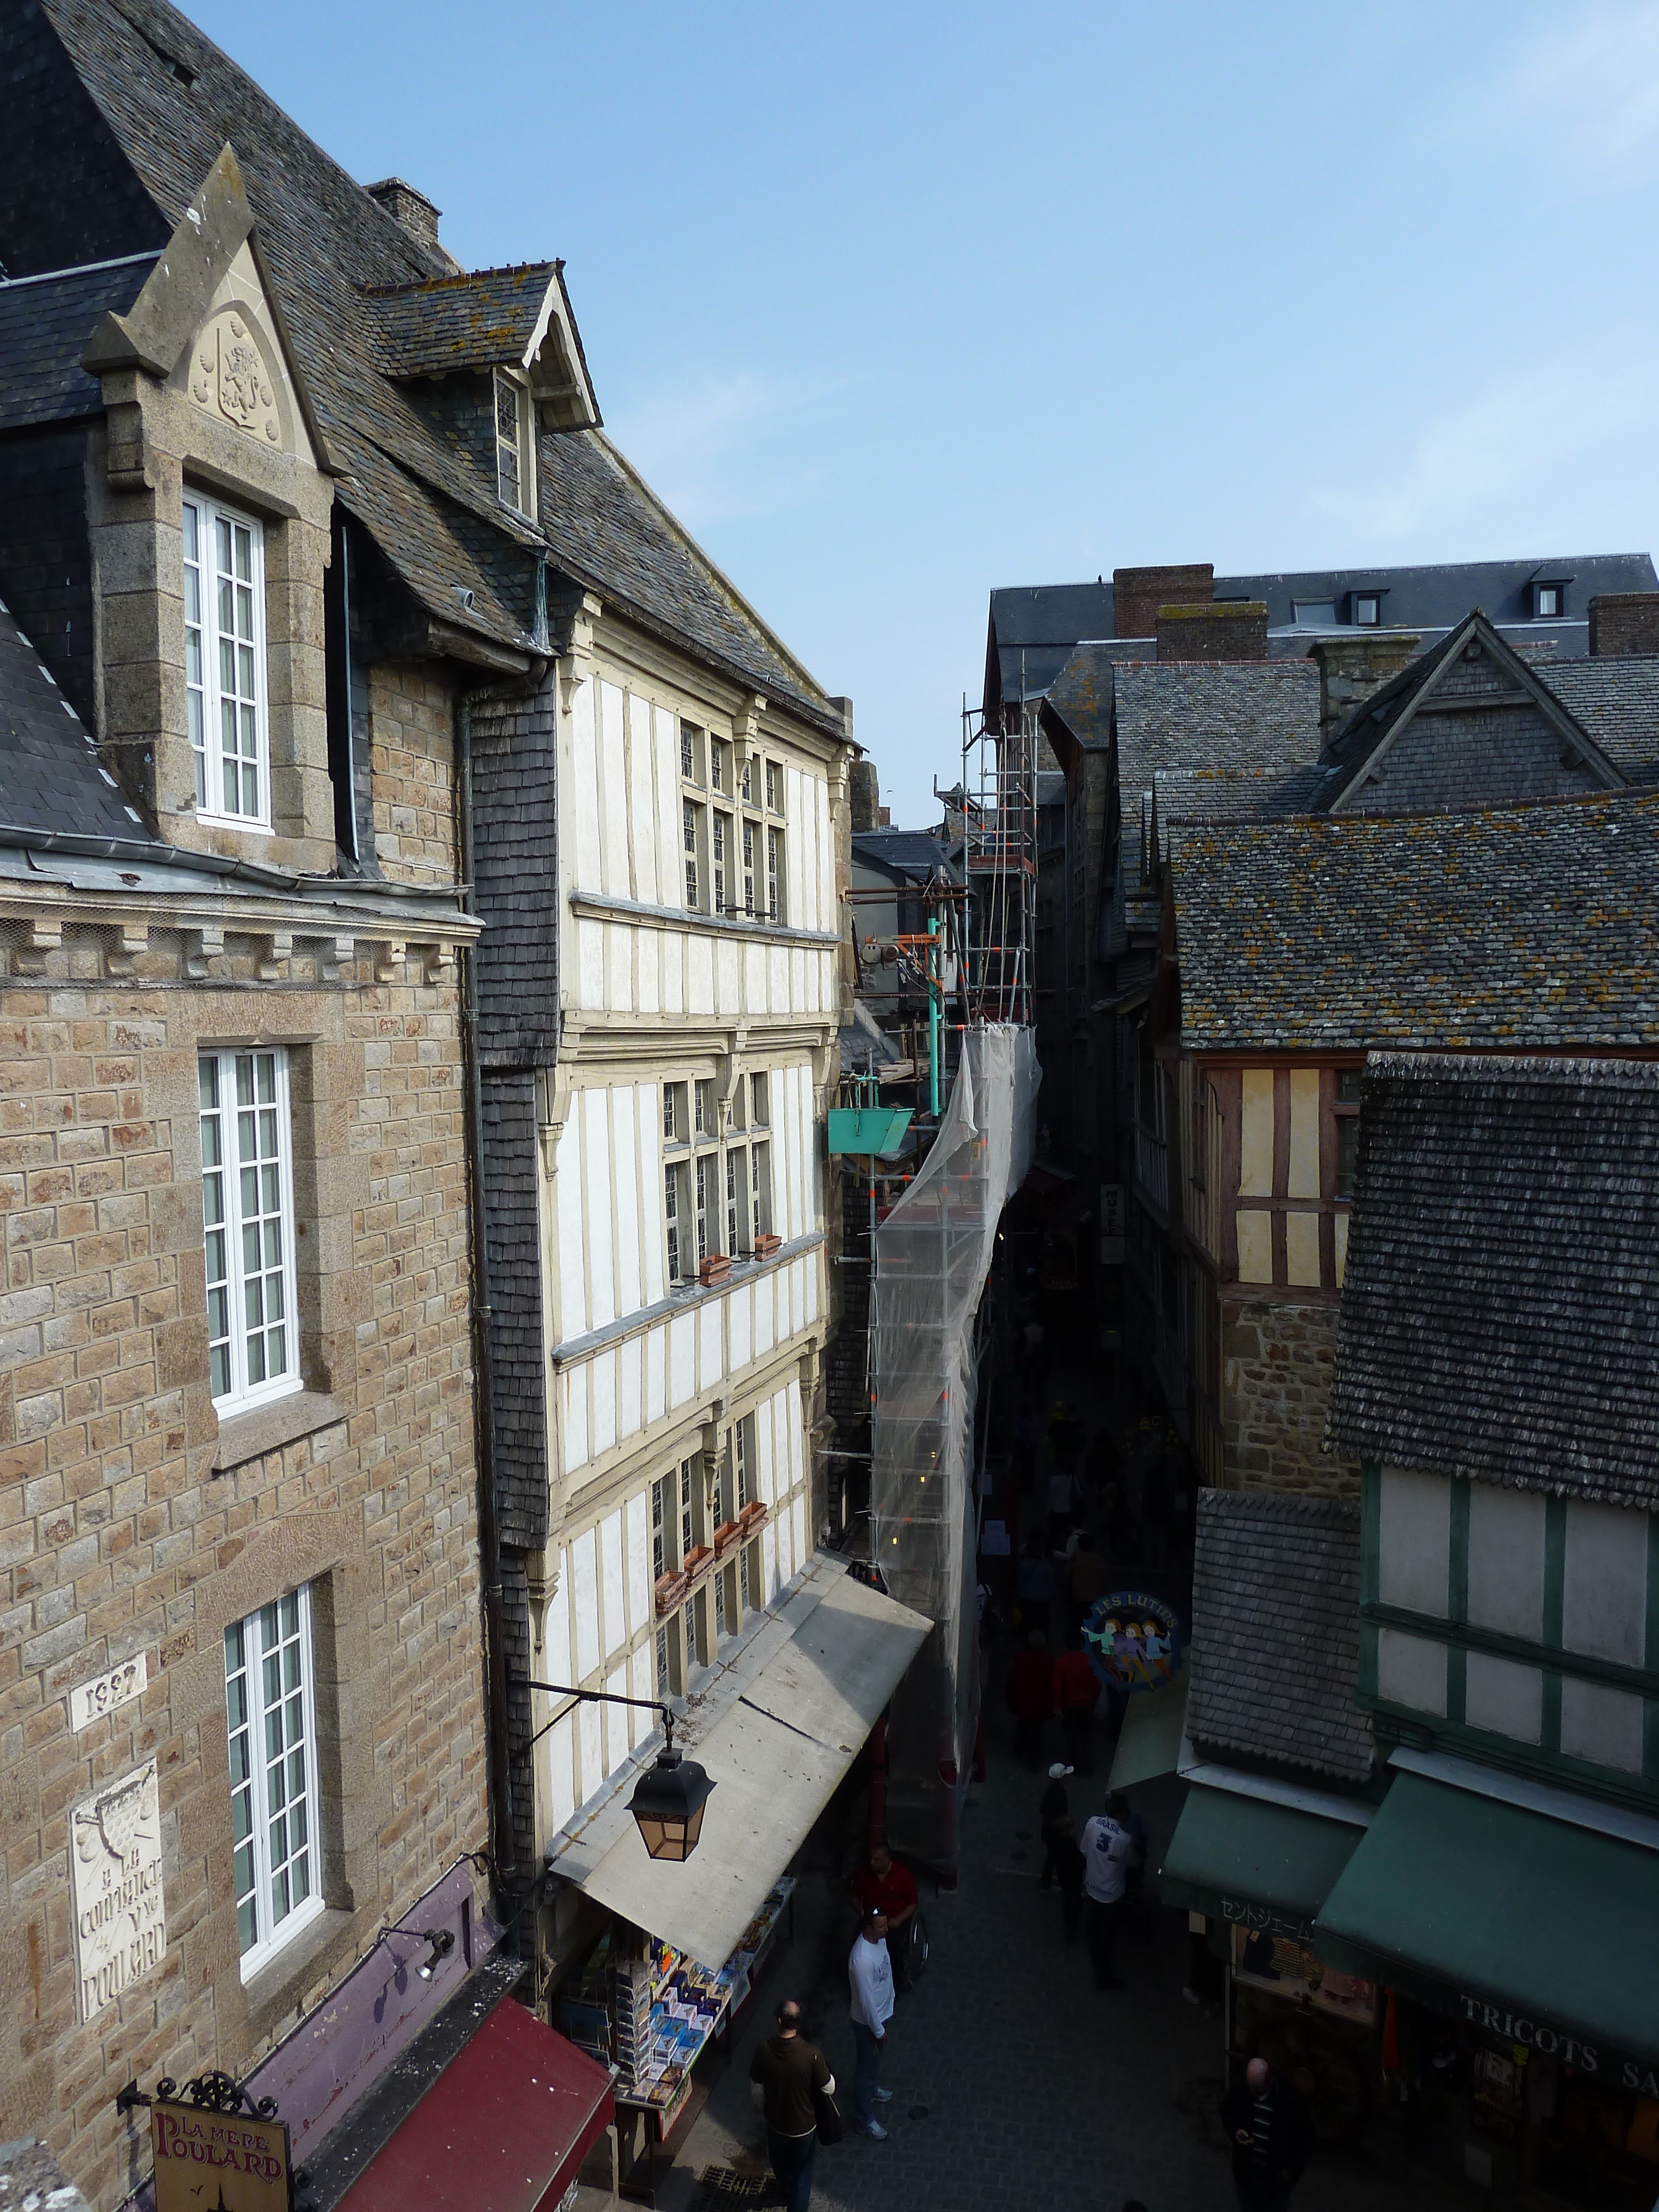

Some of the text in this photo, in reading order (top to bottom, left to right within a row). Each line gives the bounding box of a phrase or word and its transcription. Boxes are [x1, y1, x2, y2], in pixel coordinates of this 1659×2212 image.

[1095, 1594, 1178, 1629] LES LUTINS
[1095, 1818, 1120, 1835] BRASIL
[1096, 1832, 1113, 1853] 3
[121, 1848, 140, 1877] LA
[80, 1858, 163, 1939] CONFIANCE
[1220, 1896, 1314, 1943] セントジェーム
[82, 1922, 165, 2021] POULARD
[1460, 1994, 1598, 2072] TRICOTS
[155, 2111, 284, 2183] POULARD
[181, 2116, 270, 2152] LA MERE
